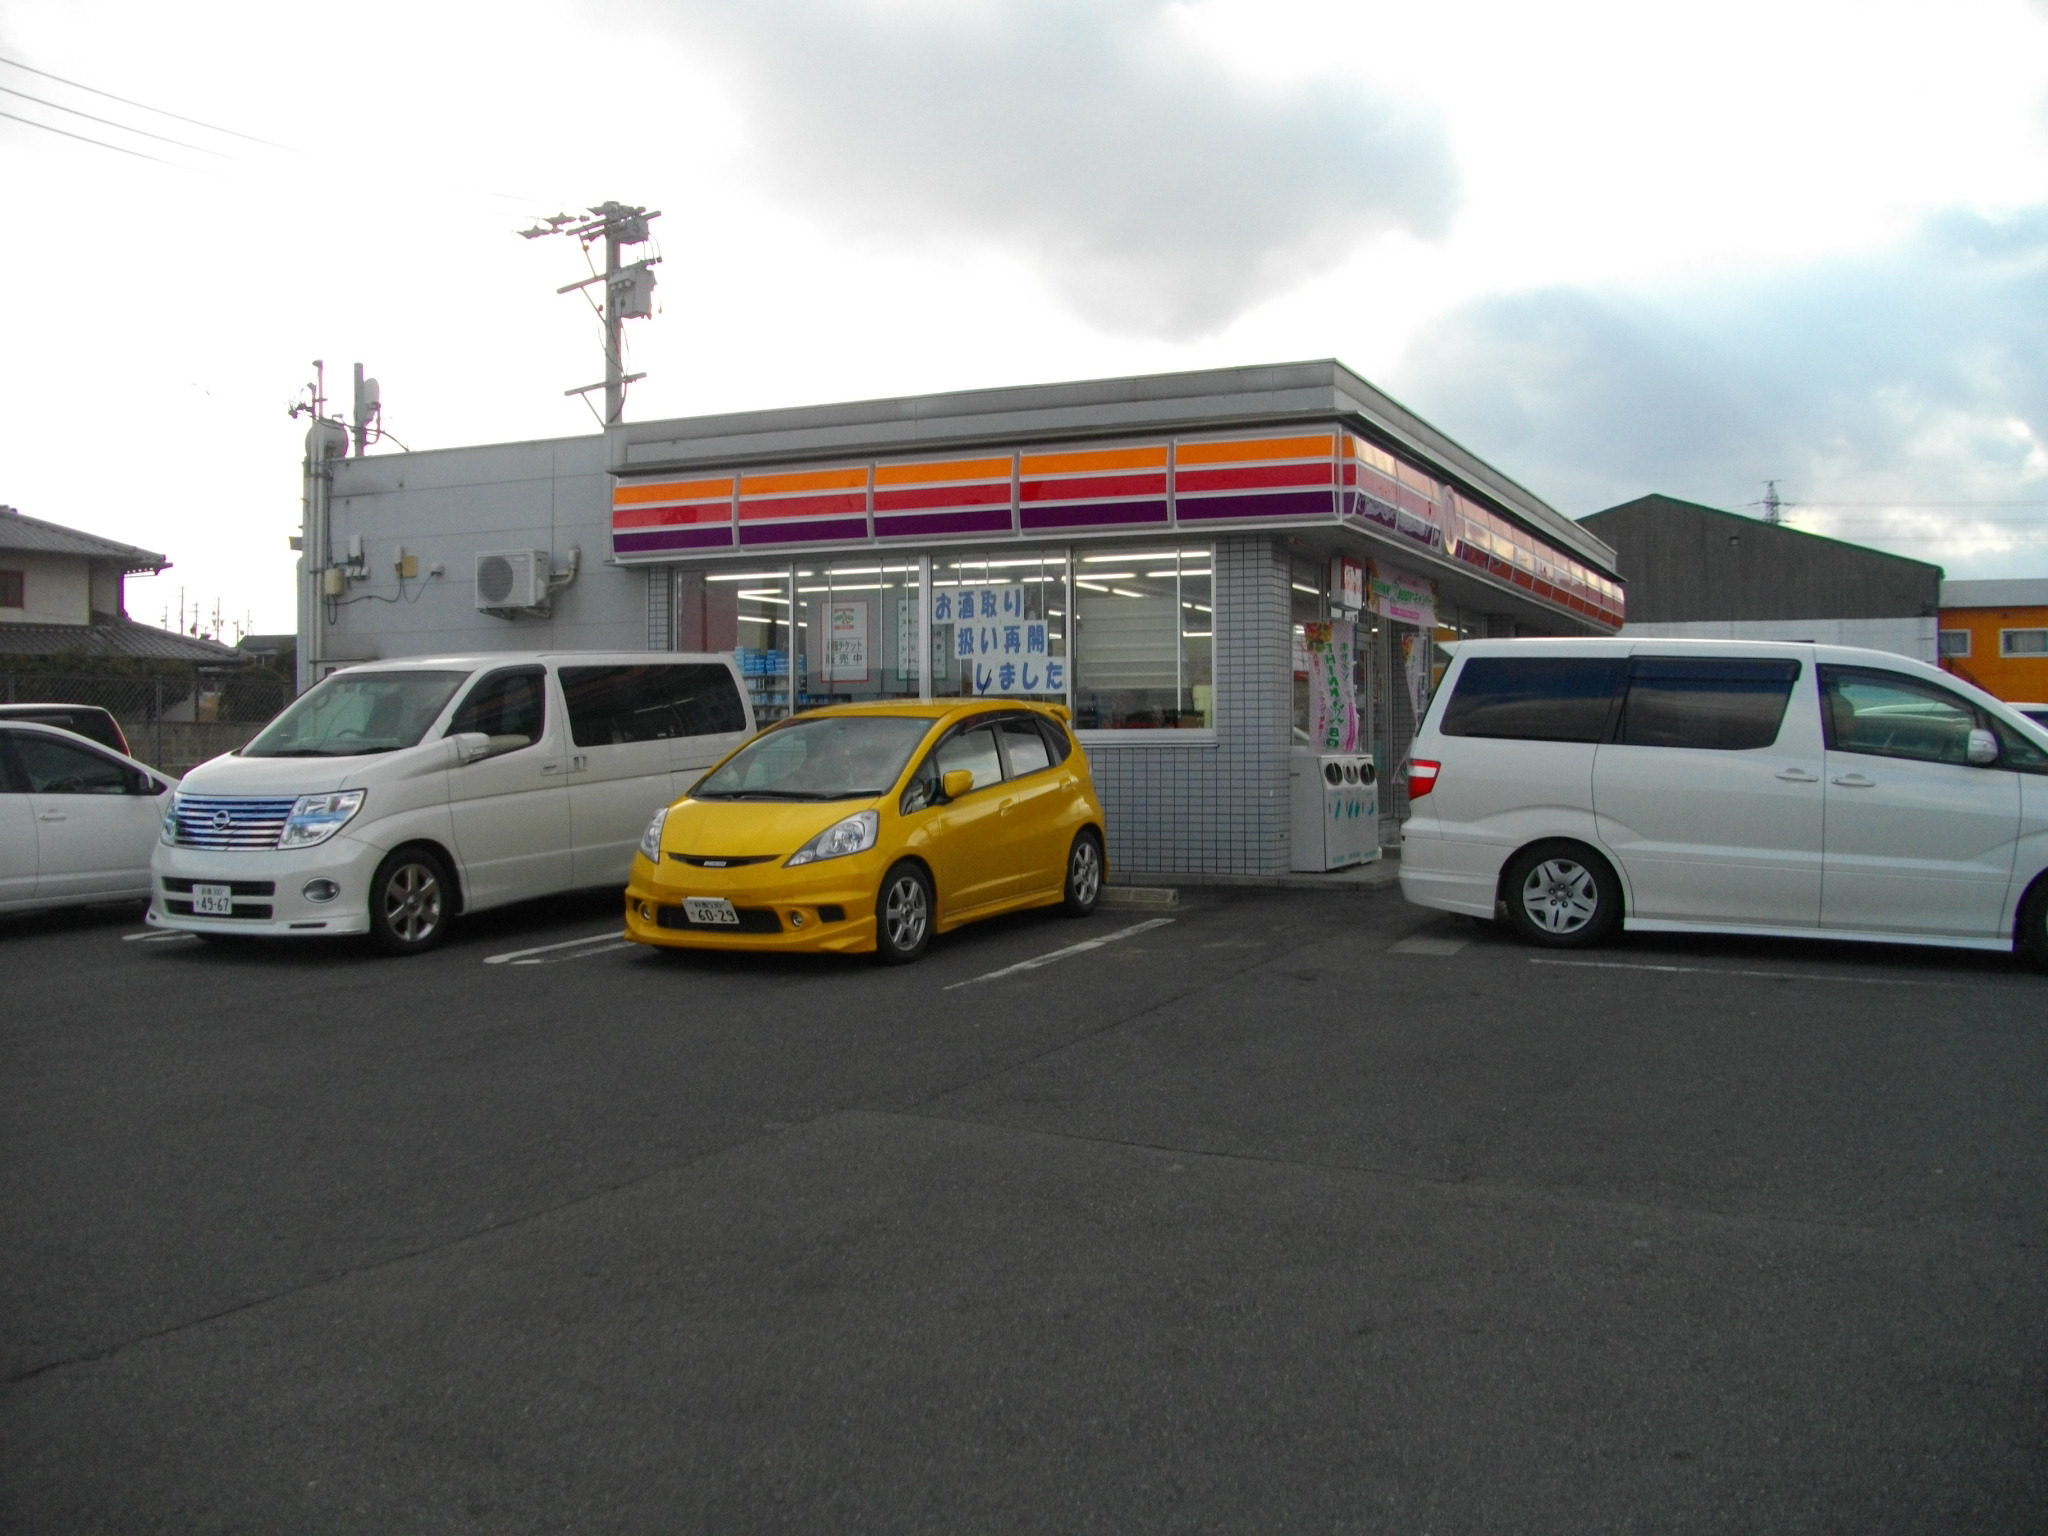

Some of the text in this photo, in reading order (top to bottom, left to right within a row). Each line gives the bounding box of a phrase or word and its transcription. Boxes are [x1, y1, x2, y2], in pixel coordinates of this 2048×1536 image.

[935, 589, 1021, 619] お酒取り
[958, 624, 1045, 656] 扱い再開
[976, 662, 1063, 691] しました
[201, 896, 229, 912] 49-67
[698, 909, 736, 922] 60-29
